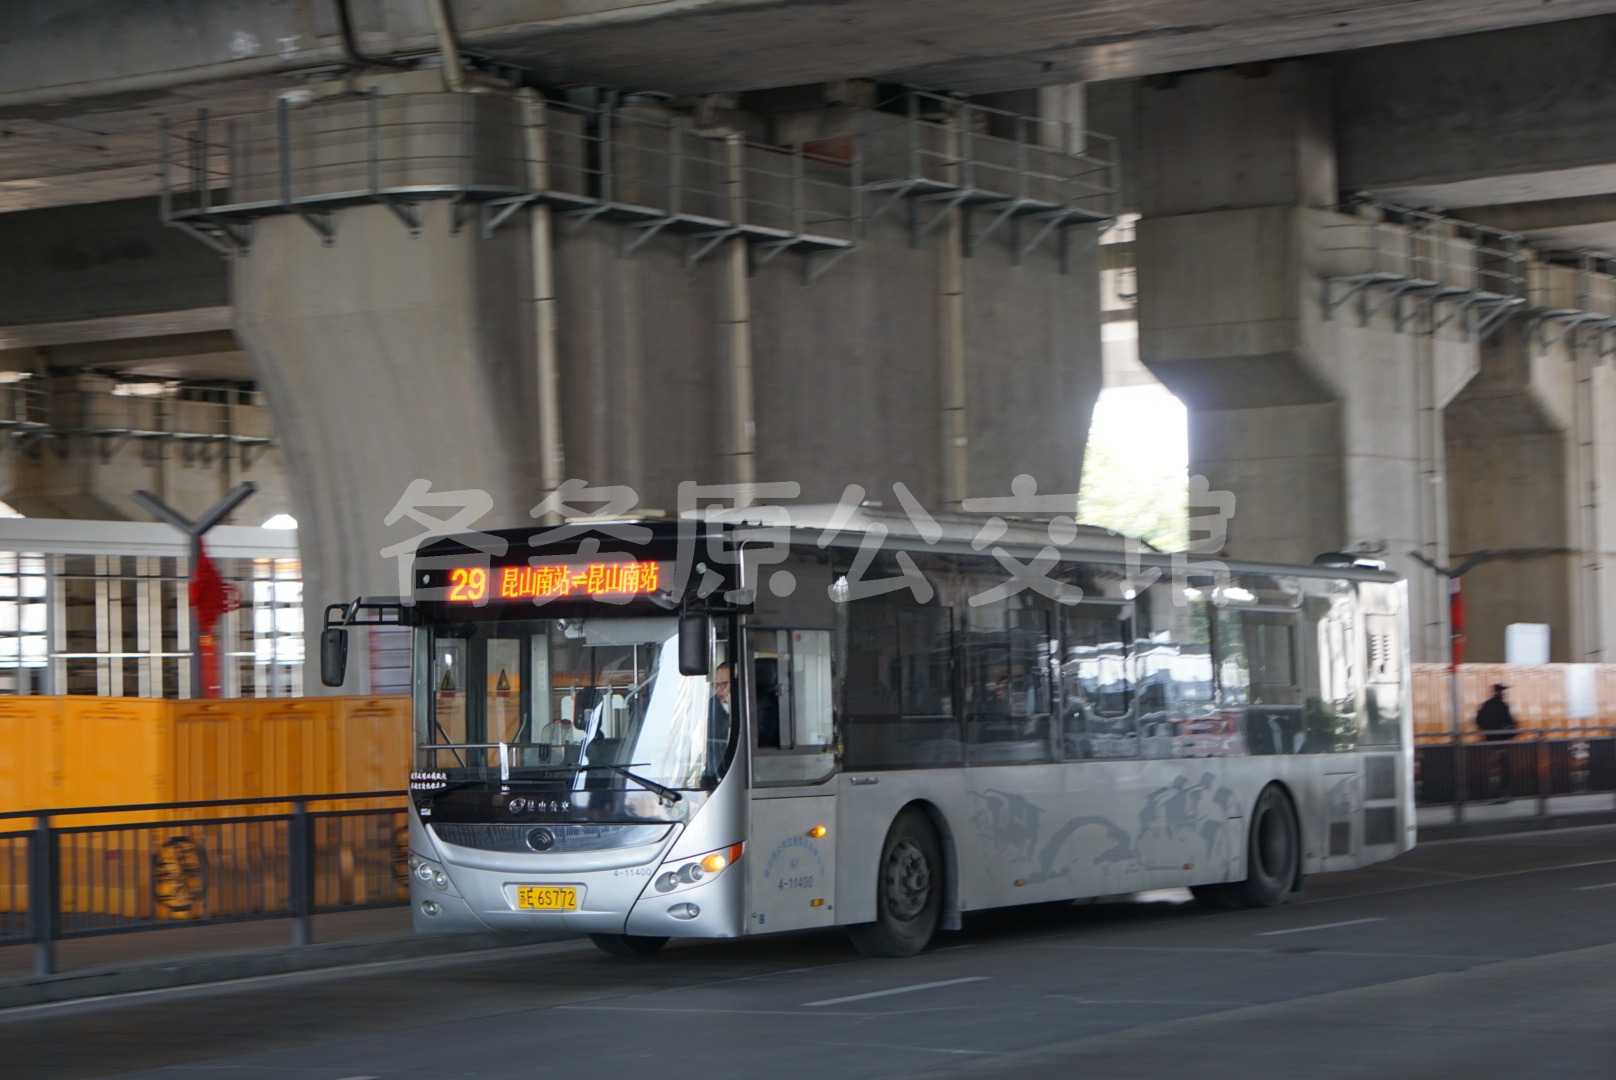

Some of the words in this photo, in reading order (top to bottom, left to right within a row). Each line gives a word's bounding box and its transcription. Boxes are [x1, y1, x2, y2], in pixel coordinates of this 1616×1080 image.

[450, 567, 486, 601] 29
[501, 565, 571, 598] 昆山南站
[587, 561, 659, 594] 昆山南站
[613, 868, 652, 877] 4-11400
[778, 876, 814, 890] 4-11400
